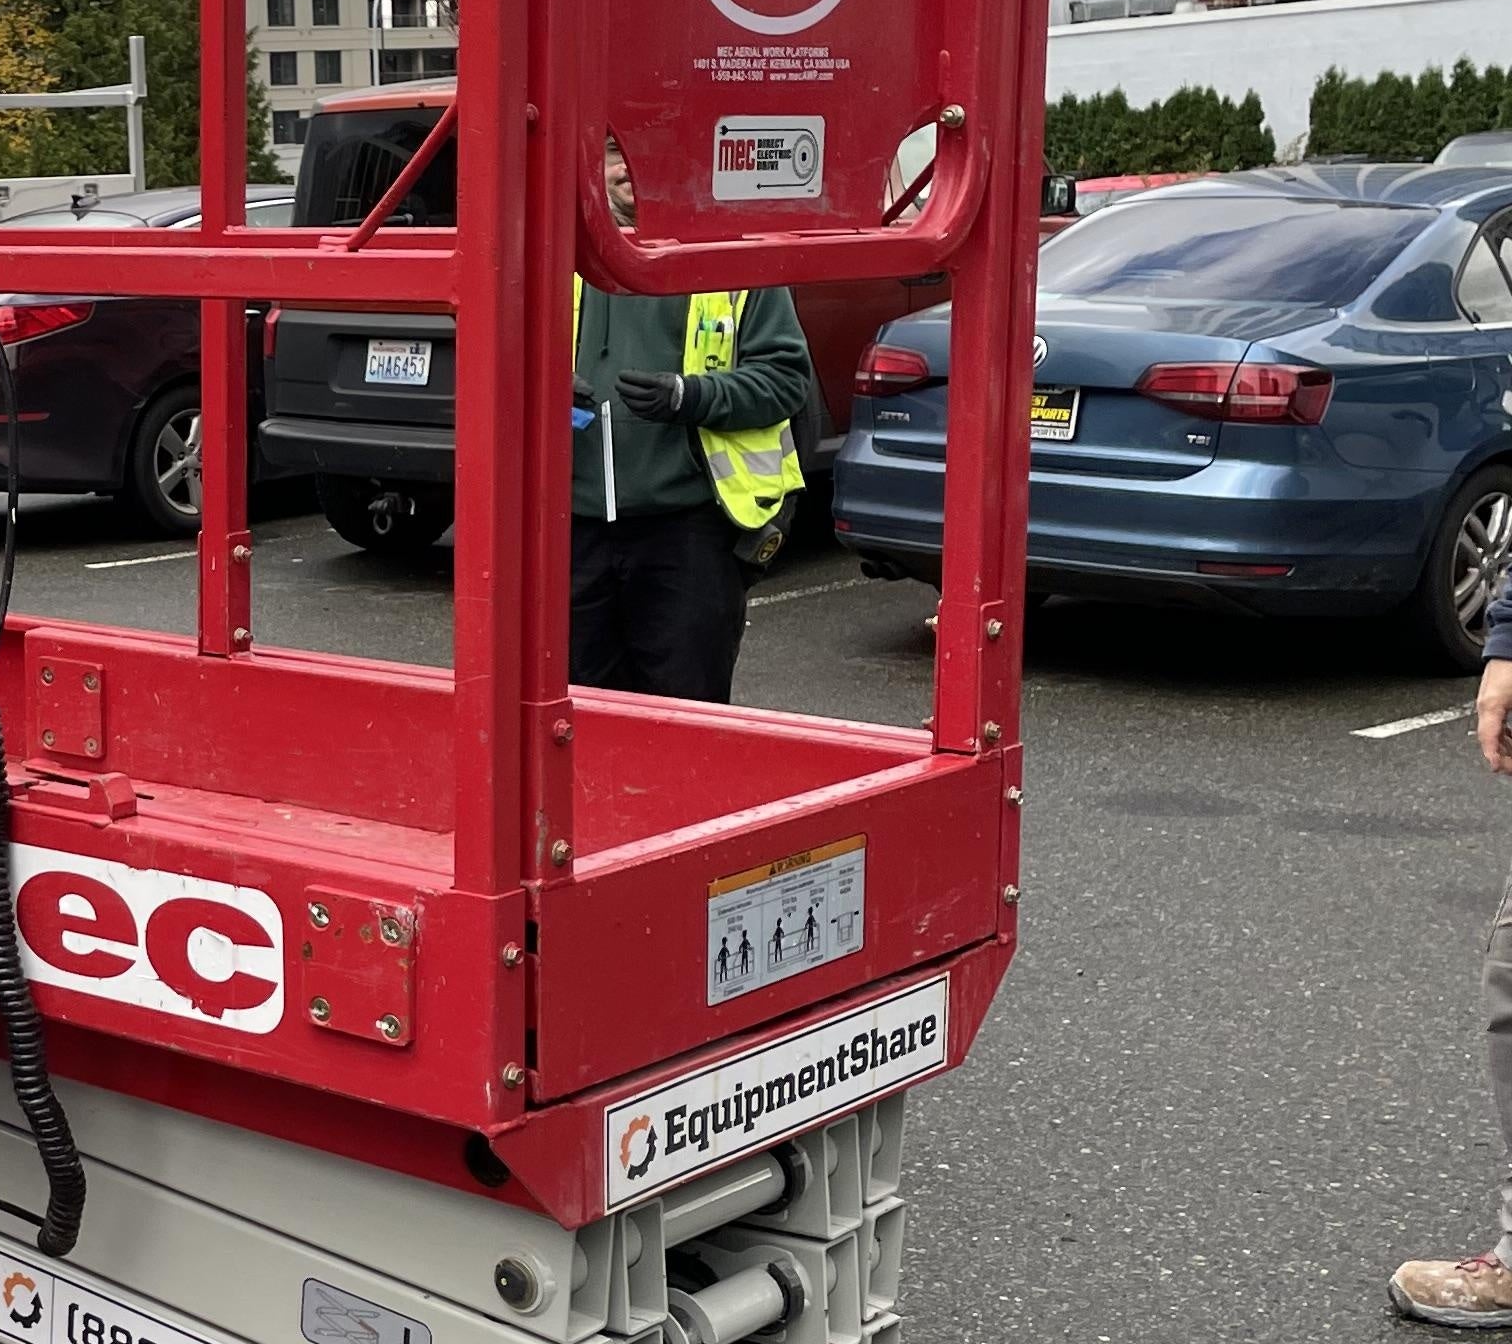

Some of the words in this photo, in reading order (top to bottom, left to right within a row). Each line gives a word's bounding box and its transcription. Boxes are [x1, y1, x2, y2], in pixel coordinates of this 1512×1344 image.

[763, 46, 786, 58] WORK
[757, 138, 785, 149] DIRECT
[756, 149, 792, 160] ELECTRIC
[756, 160, 779, 171] DRIVE
[663, 1013, 937, 1156] EquipmentShare
